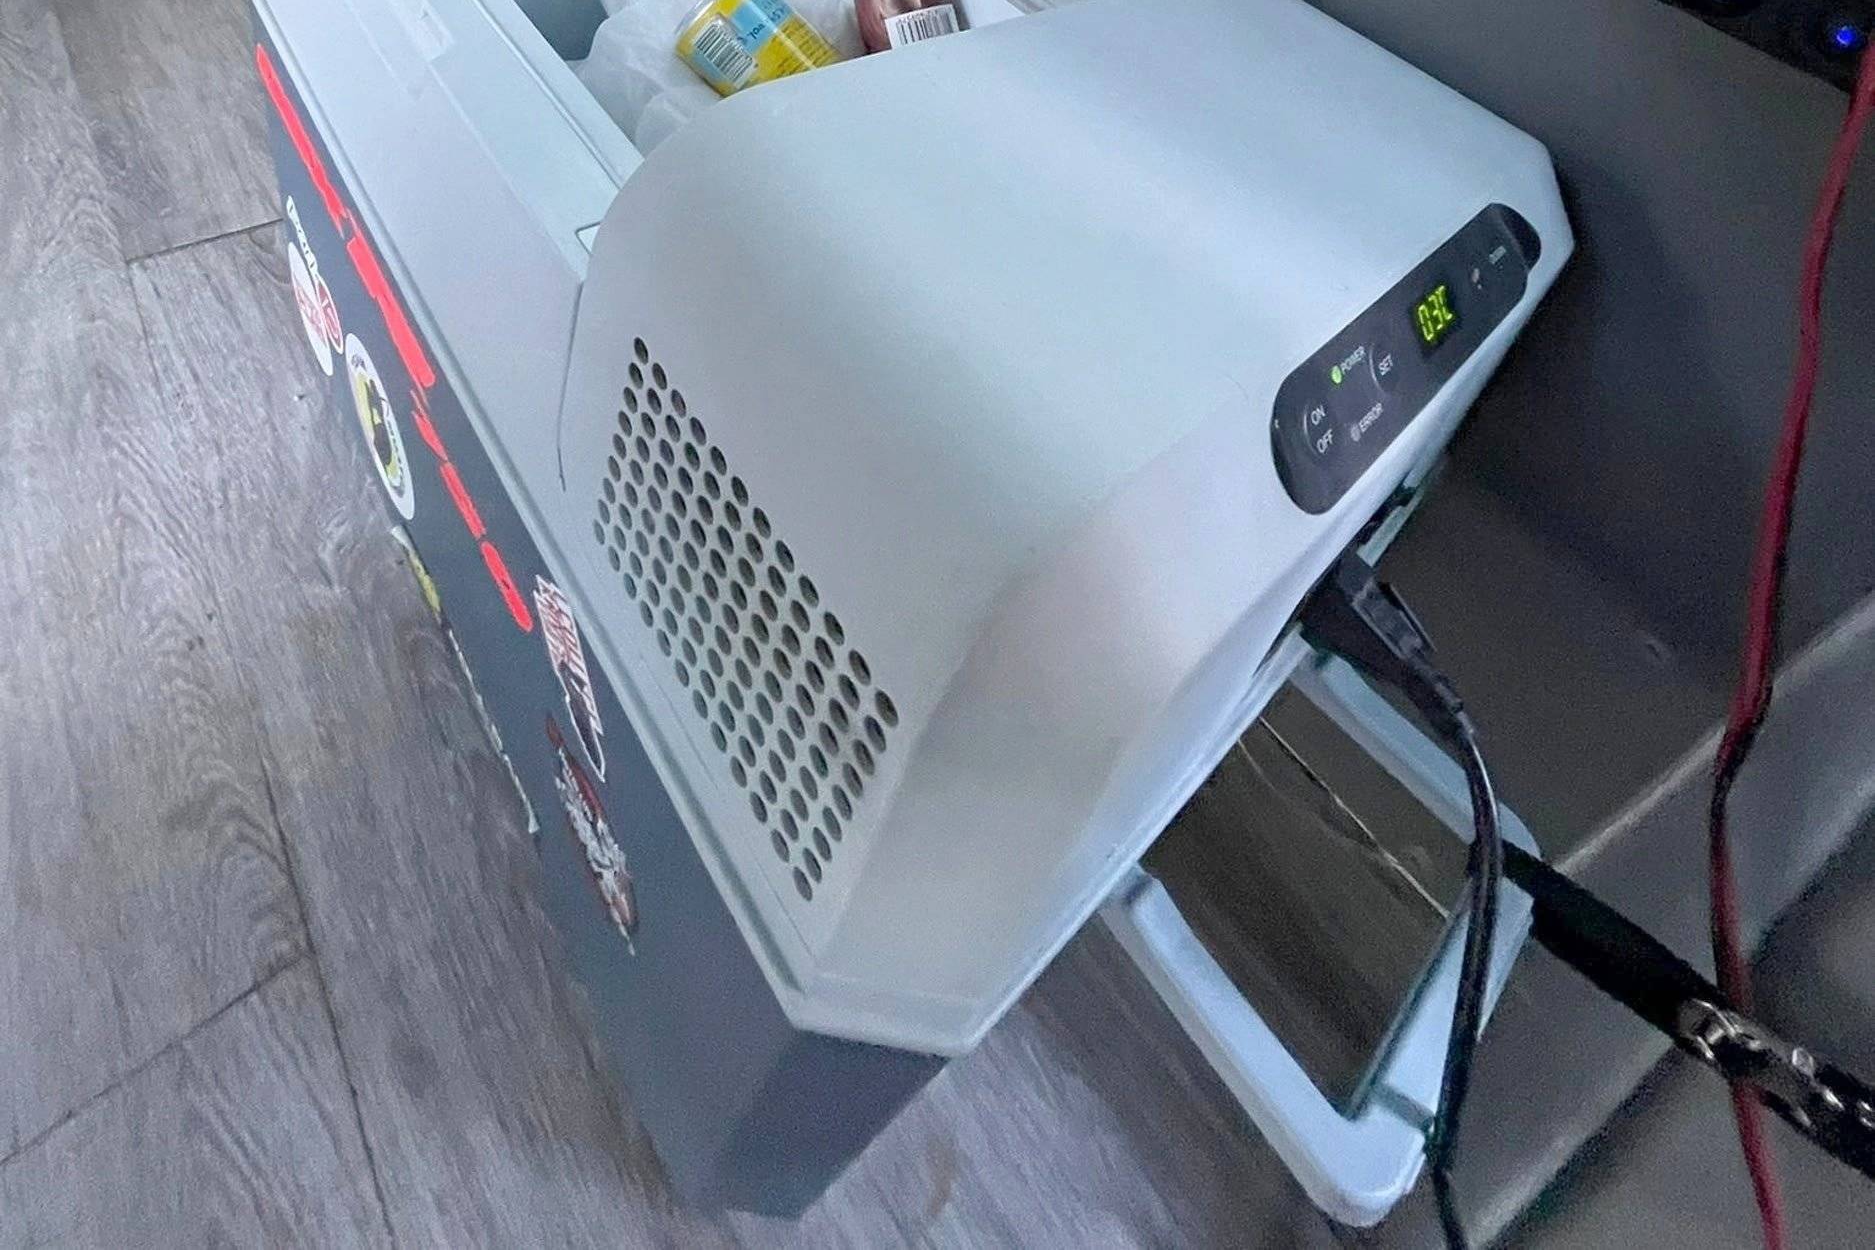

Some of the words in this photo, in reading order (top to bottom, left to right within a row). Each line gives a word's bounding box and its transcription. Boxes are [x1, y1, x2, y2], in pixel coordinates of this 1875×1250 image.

[1340, 345, 1366, 375] POWER
[1378, 354, 1393, 376] SET
[1310, 404, 1326, 426] ON
[1359, 402, 1384, 432] ERROR
[1316, 428, 1334, 454] OFF
